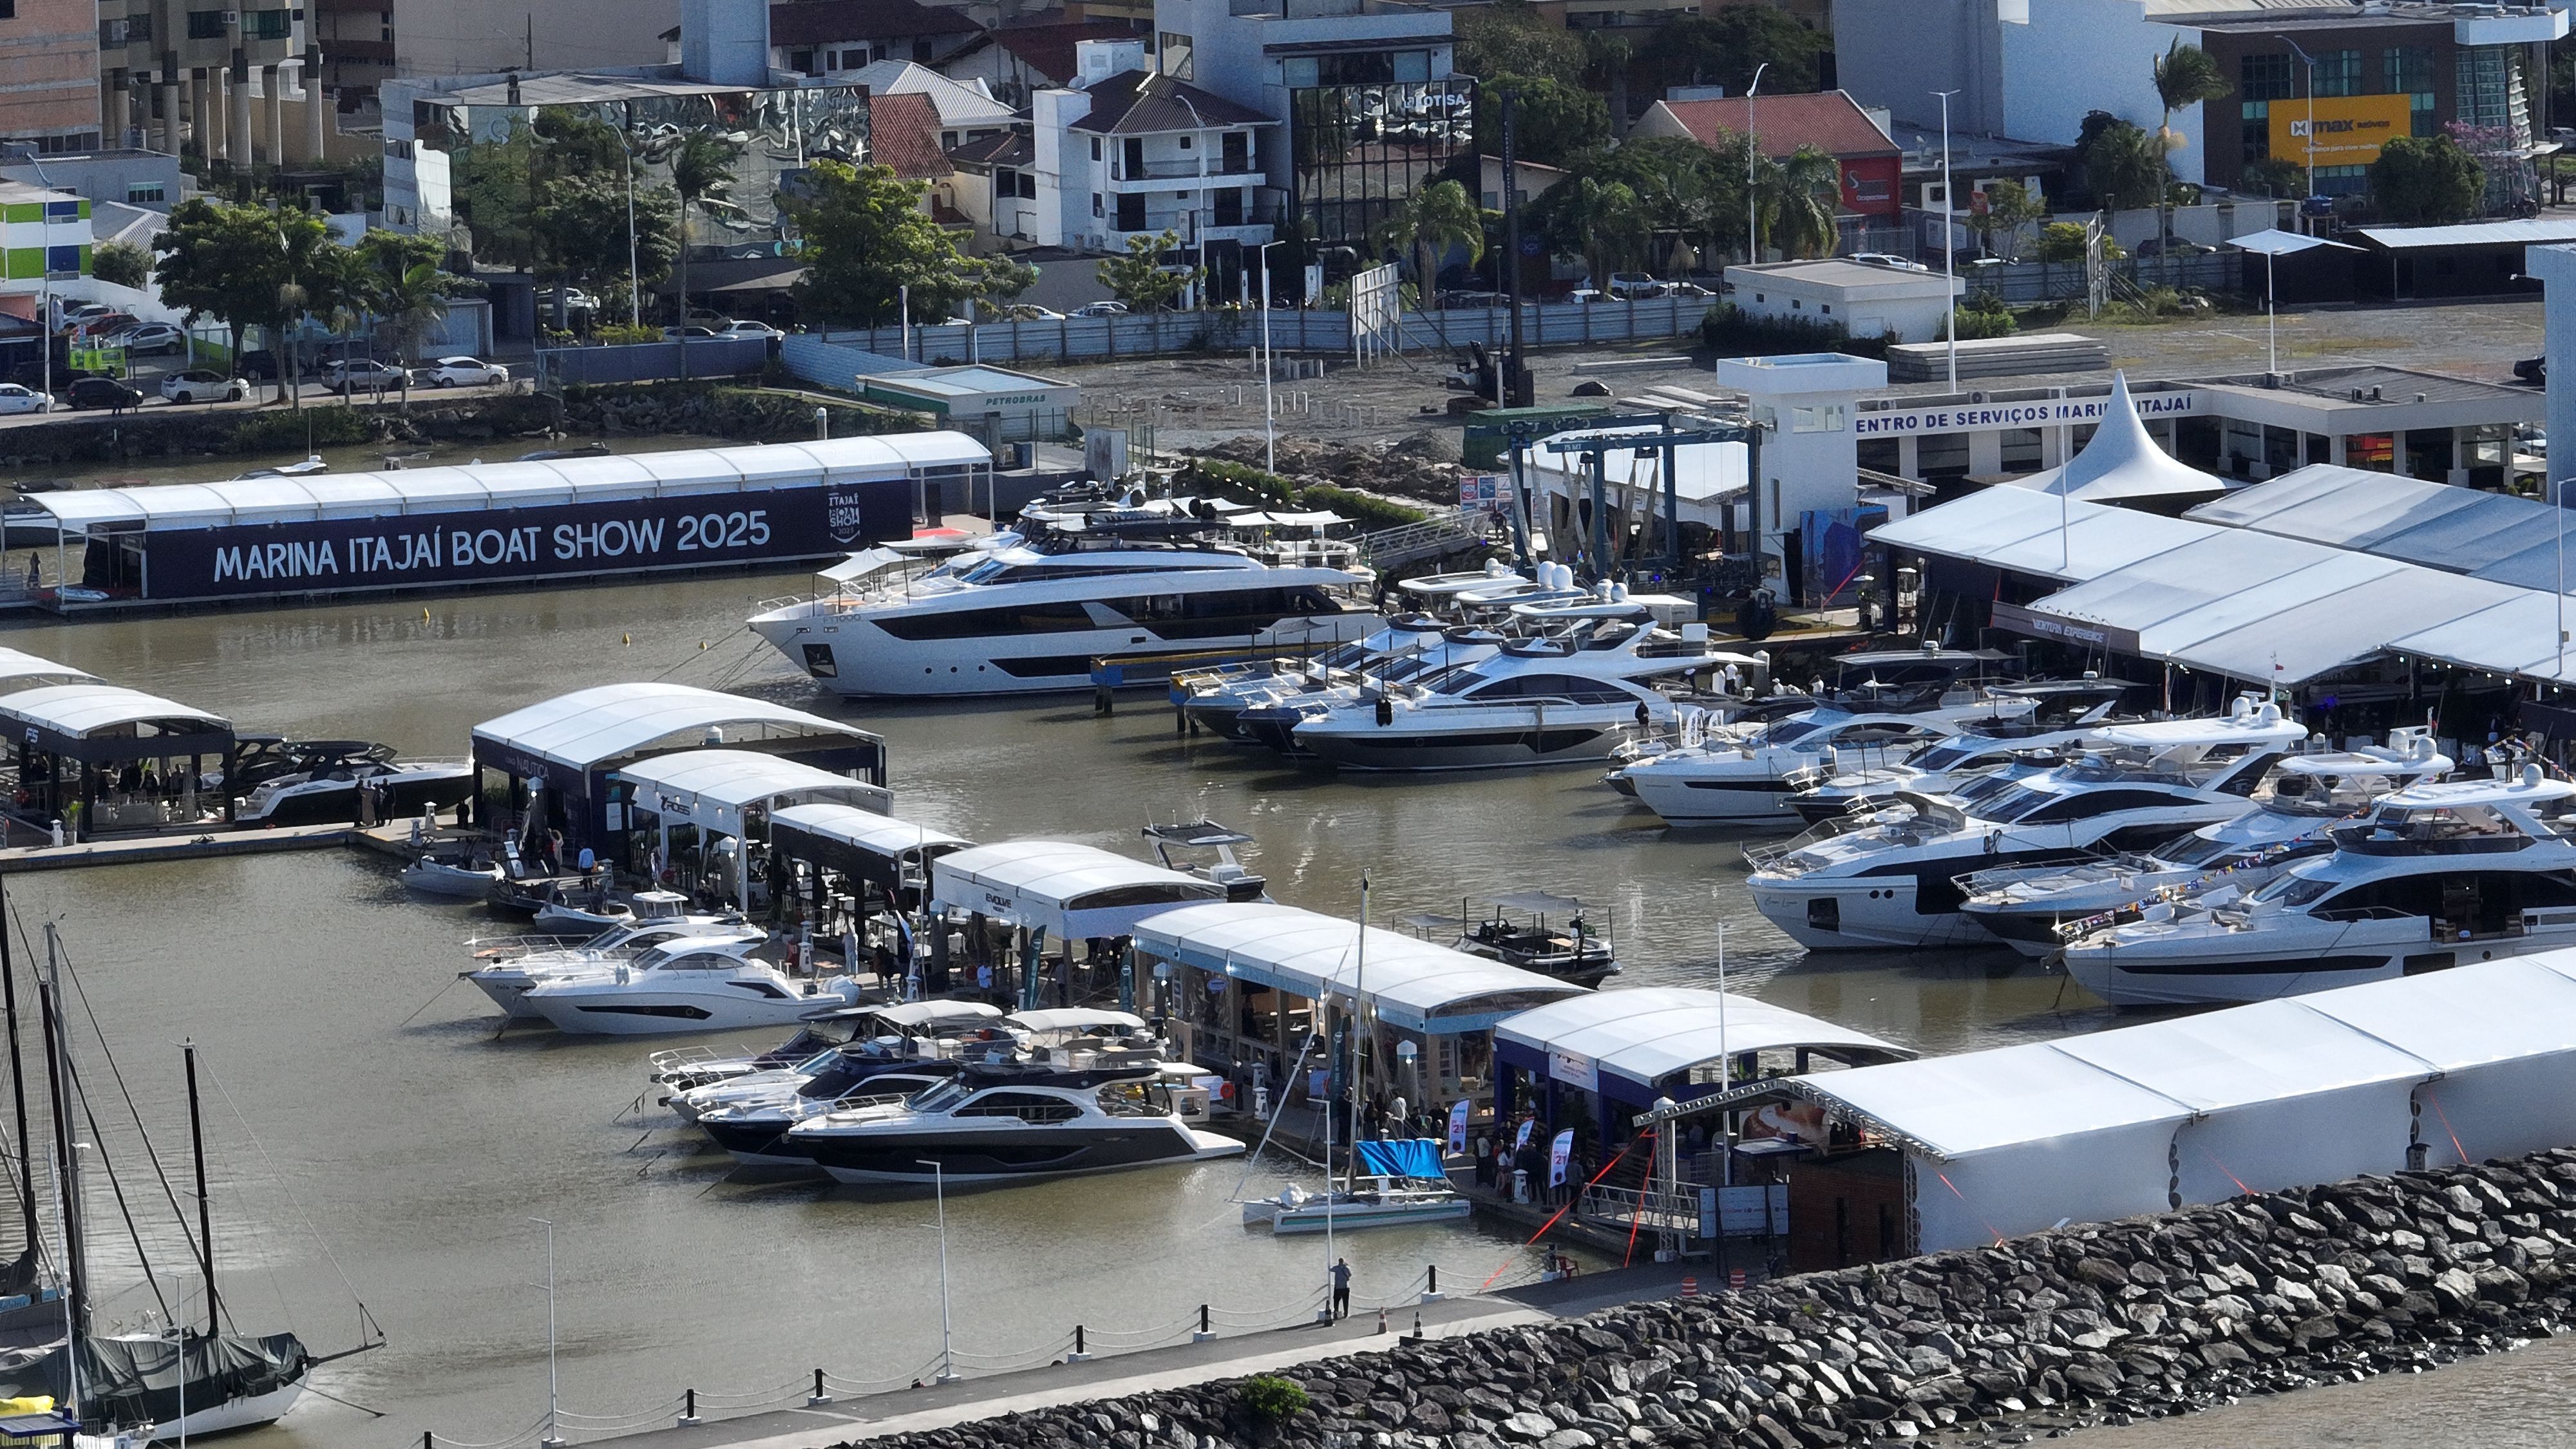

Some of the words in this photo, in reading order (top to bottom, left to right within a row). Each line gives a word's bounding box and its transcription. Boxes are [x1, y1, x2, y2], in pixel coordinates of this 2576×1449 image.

[1416, 94, 1465, 108] LOTISA
[2313, 120, 2354, 133] max
[985, 395, 1046, 406] PETROBRAS
[1855, 415, 1918, 433] ENTRO
[1926, 413, 1949, 428] DE
[1956, 406, 2049, 426] SERVIÇOS
[2056, 402, 2108, 419] MARI
[2137, 393, 2191, 415] ITAJAÍ
[829, 493, 858, 506] ITAJAÍ
[829, 516, 860, 527] SHOW
[214, 540, 339, 582] MARINA
[348, 525, 442, 573] ITAJAÍ
[452, 526, 541, 566] BOAT
[553, 518, 665, 560] SHOW
[677, 510, 771, 551] 2025
[2031, 618, 2063, 635] VENTURA
[985, 893, 1012, 909] EVOLVE
[1453, 1124, 1464, 1134] 21
[1555, 1155, 1567, 1166] 21
